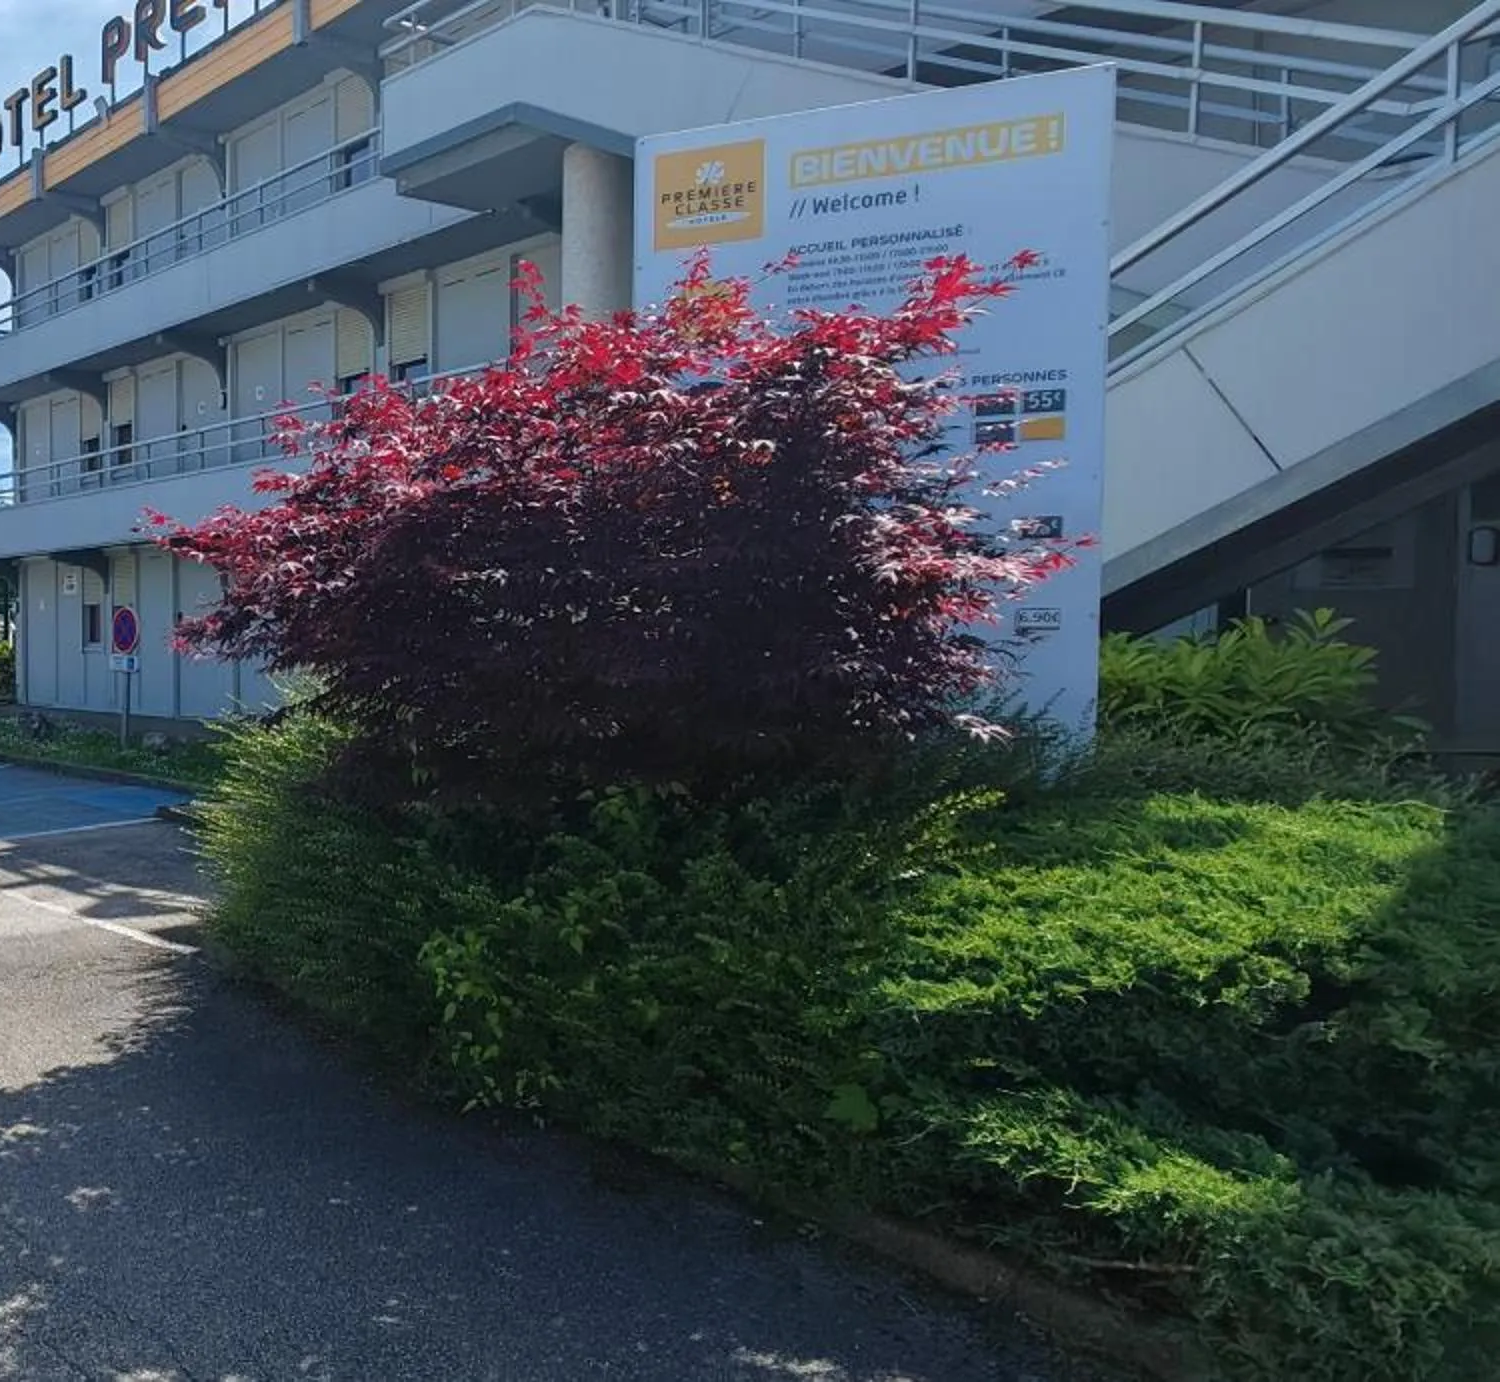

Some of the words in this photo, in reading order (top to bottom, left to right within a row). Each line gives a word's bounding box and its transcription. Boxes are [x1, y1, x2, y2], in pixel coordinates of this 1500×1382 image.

[101, 0, 226, 84] PRE
[795, 121, 1037, 184] BIENVENUE
[675, 195, 745, 216] CLASSE
[812, 188, 907, 215] Welcome
[789, 240, 847, 256] ACCUEIL
[851, 224, 964, 249] PERSONNALISÉ
[971, 368, 1069, 387] PERSONNES
